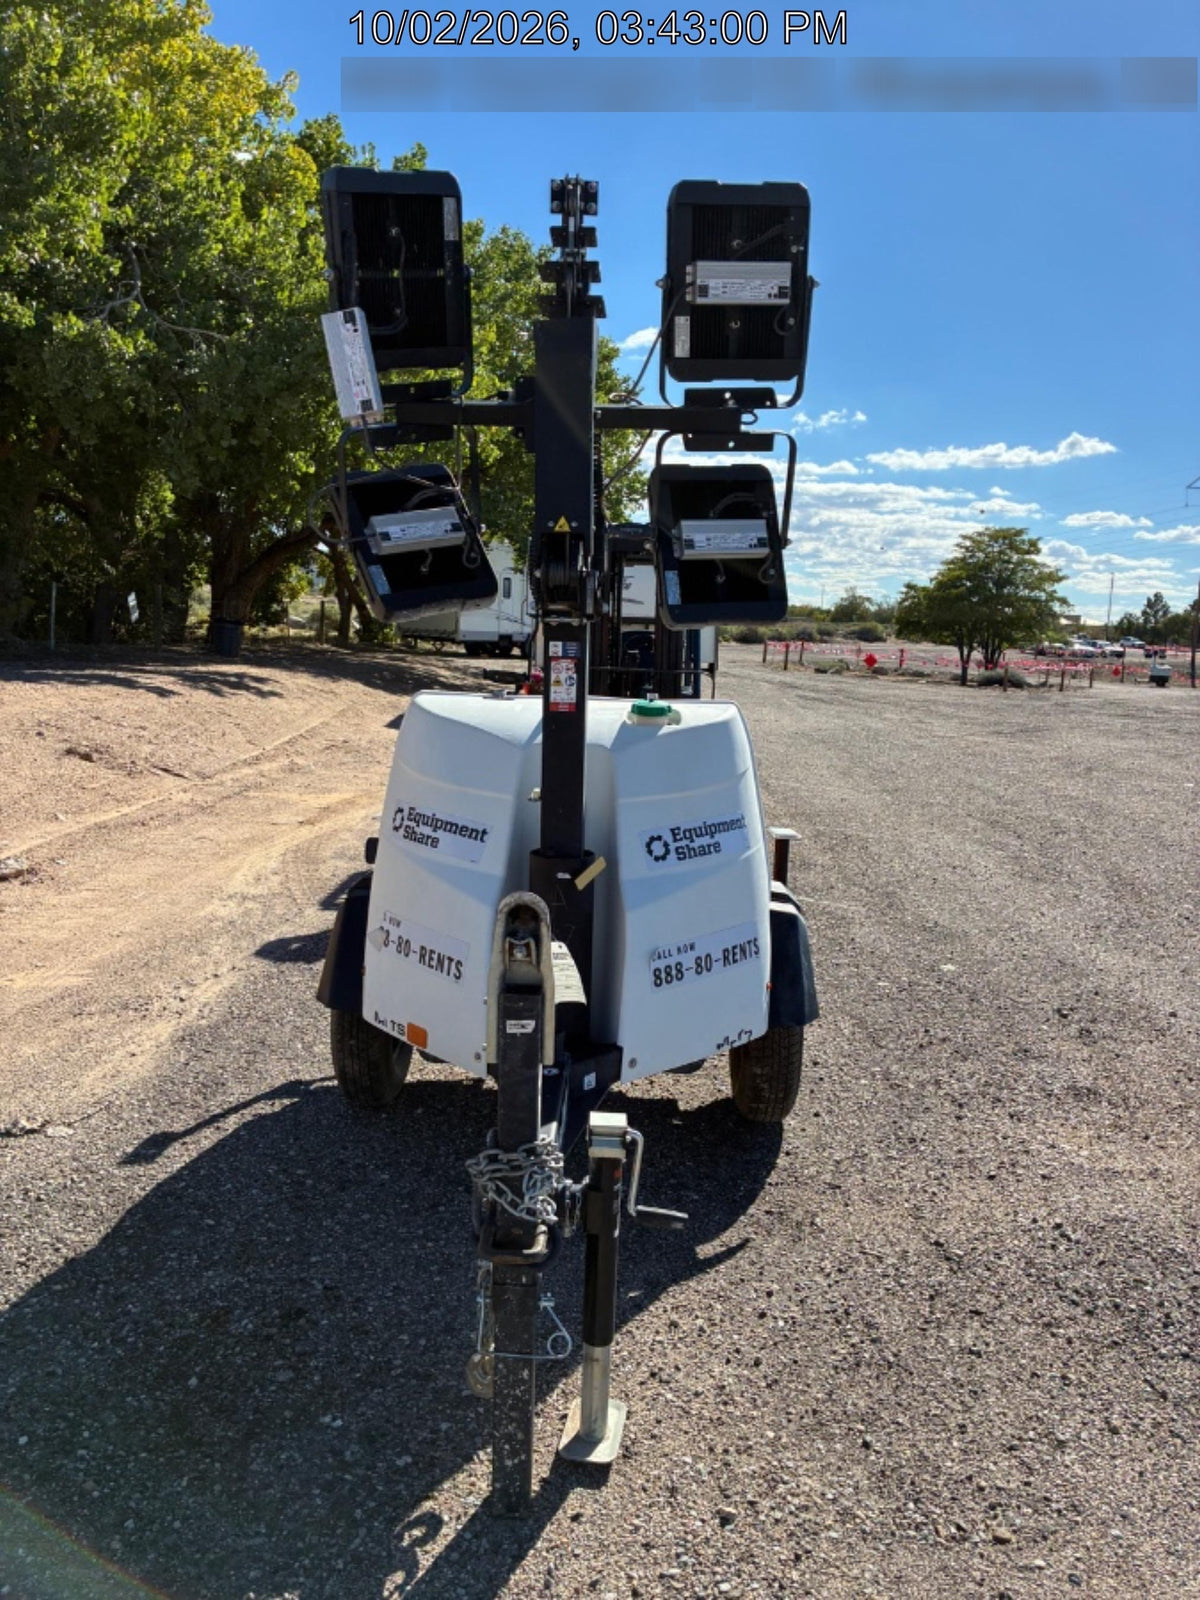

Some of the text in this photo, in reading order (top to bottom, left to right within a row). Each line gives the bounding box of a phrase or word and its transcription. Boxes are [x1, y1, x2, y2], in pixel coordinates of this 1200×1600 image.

[402, 825, 440, 848] Share
[406, 806, 489, 843] Equipment
[670, 814, 747, 843] Equipment
[675, 841, 722, 861] Share
[378, 926, 464, 980] 8-80-RENTS
[652, 937, 760, 988] 888-80-RENTS
